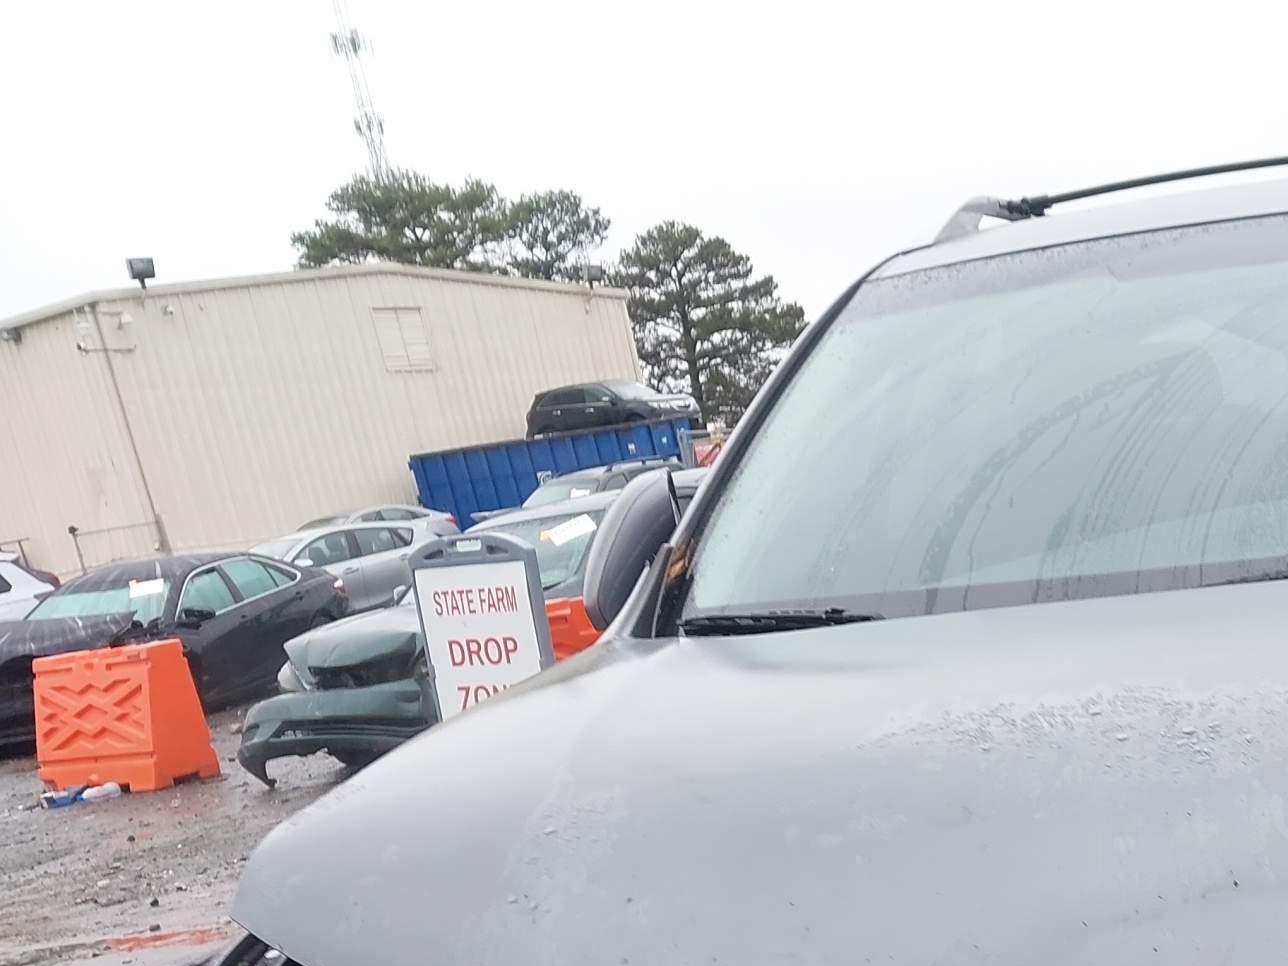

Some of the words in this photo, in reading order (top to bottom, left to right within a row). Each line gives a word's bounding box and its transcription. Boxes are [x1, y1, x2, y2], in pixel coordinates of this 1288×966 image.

[432, 588, 477, 617] STATE
[479, 585, 518, 614] FARM
[447, 636, 519, 668] DROP
[456, 684, 514, 712] ZO
